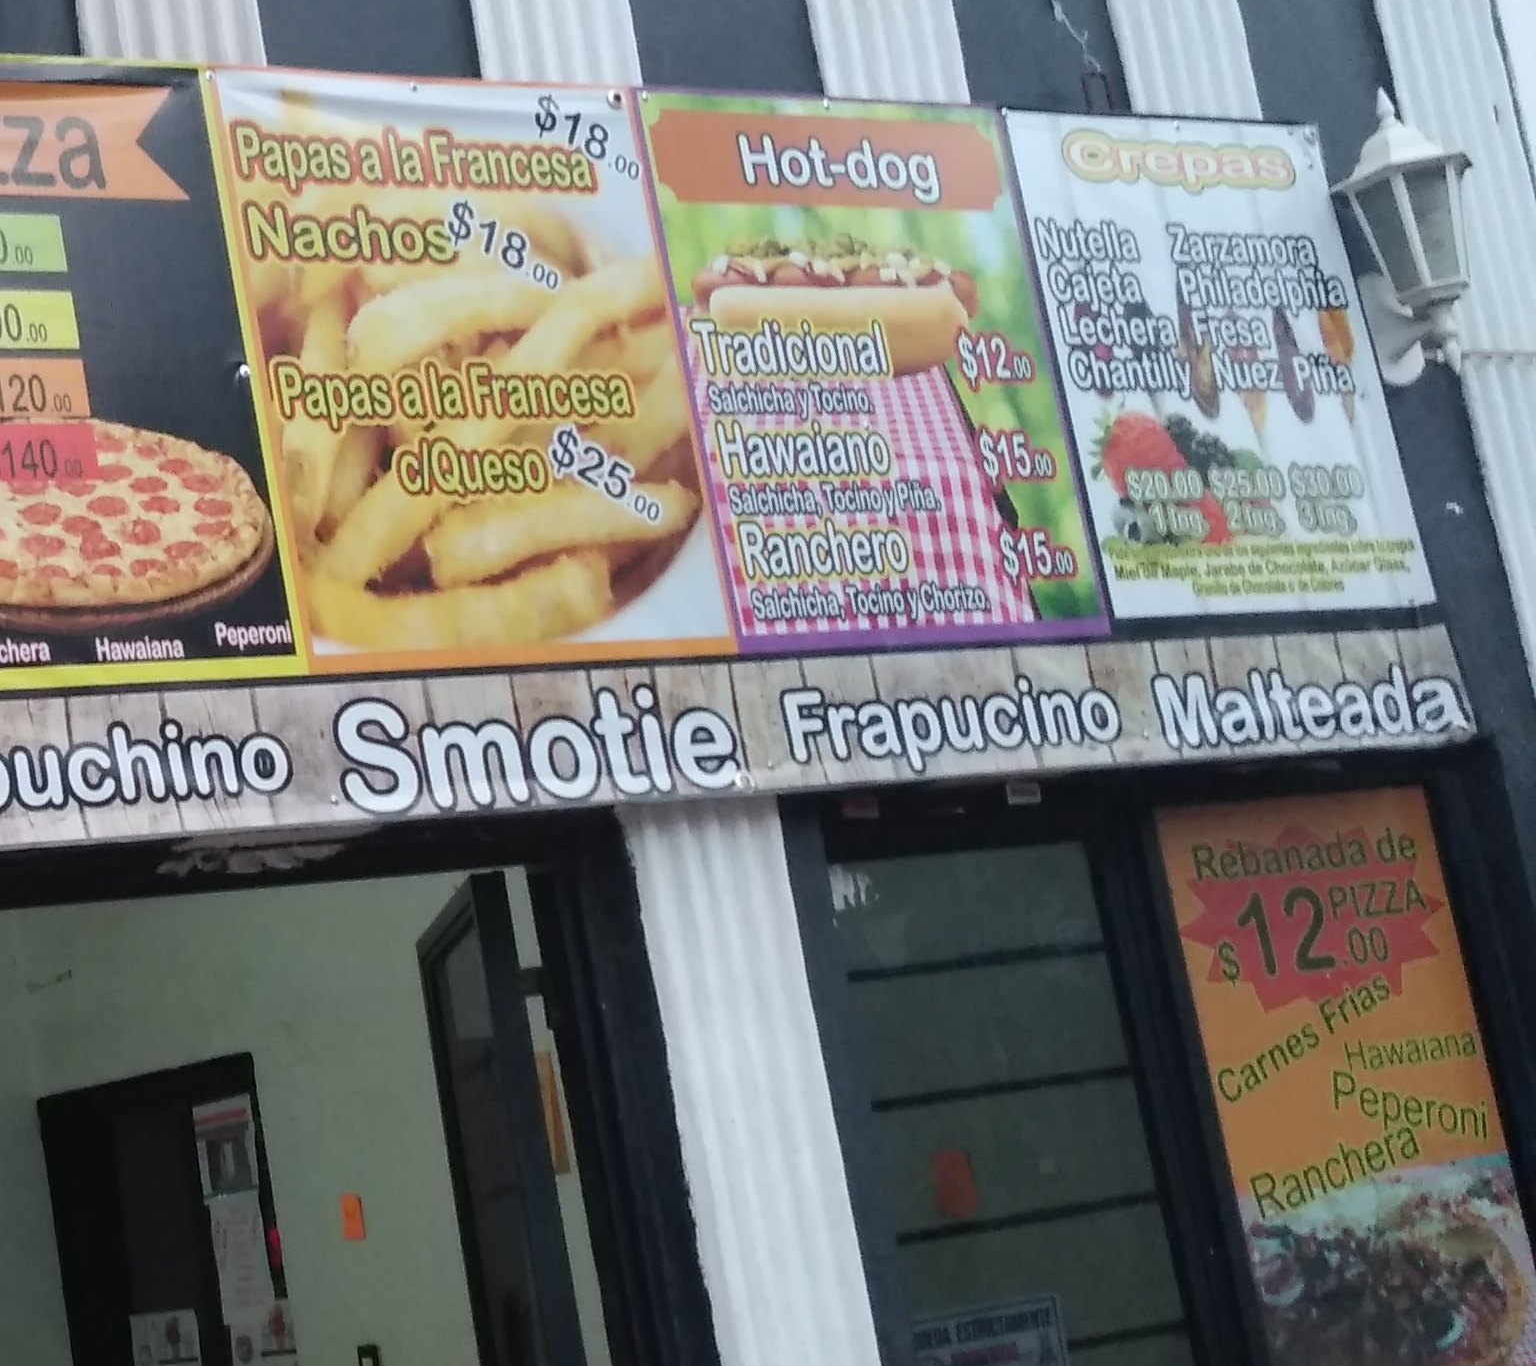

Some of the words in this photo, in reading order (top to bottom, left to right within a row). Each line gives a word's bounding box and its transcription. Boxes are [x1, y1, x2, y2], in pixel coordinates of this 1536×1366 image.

[235, 131, 351, 188] Papas
[359, 146, 383, 180] a
[389, 134, 423, 183] la
[430, 135, 594, 189] Francesa
[534, 93, 640, 181] $18.00
[1066, 134, 1293, 189] Crepas
[737, 133, 941, 204] Hot-dog
[246, 206, 455, 260] Nachos
[448, 201, 560, 291] $18.00
[1035, 217, 1141, 263] Nutella
[1166, 223, 1318, 266] Zarzamora
[1047, 261, 1144, 312] Cajeta
[1177, 264, 1350, 316] Philadelphia
[692, 321, 890, 376] Tradicional
[958, 333, 1033, 387] $12.00
[1059, 304, 1179, 347] Lechera
[1191, 307, 1272, 348] Fresa
[277, 365, 392, 428] Papas
[400, 381, 424, 418] a
[431, 362, 463, 418] la
[470, 365, 631, 419] Francesa
[709, 383, 795, 414] Salchicha
[799, 391, 809, 420] y
[1069, 347, 1192, 400] Chantilly
[1210, 351, 1285, 391] Nuez
[1293, 353, 1356, 393] Piña
[550, 427, 660, 524] $25.00
[715, 420, 891, 478] Hawaiano
[979, 428, 1054, 486] $15.00
[728, 483, 824, 518] Salchicha,
[822, 482, 884, 512] Tocino
[885, 488, 896, 516] y
[1125, 467, 1205, 501] $20.00
[1209, 464, 1287, 501] $25.00
[1149, 502, 1165, 535] 1
[1226, 501, 1243, 533] 2
[1297, 500, 1317, 533] 3
[738, 518, 909, 580] Ranchero
[999, 527, 1076, 582] $15.00
[751, 588, 846, 621] Salchicha,
[846, 585, 905, 613] Tocino
[908, 590, 919, 620] y
[919, 582, 992, 613] Chorizo.
[95, 636, 185, 663] Hawaiana
[338, 688, 738, 812] Smotie
[781, 678, 1122, 772] Frapucino
[1154, 671, 1464, 751] Malteada
[1190, 832, 1367, 883] Rebanada
[1376, 827, 1418, 864] de
[1217, 886, 1389, 988] $12.00
[1330, 877, 1428, 921] PIZZA
[1217, 1023, 1321, 1104] Carnes
[1320, 975, 1392, 1036] Frias
[1344, 1030, 1479, 1073] Hawaiana
[1331, 1070, 1489, 1141] Peperoni
[1249, 1126, 1421, 1218] Ranchera
